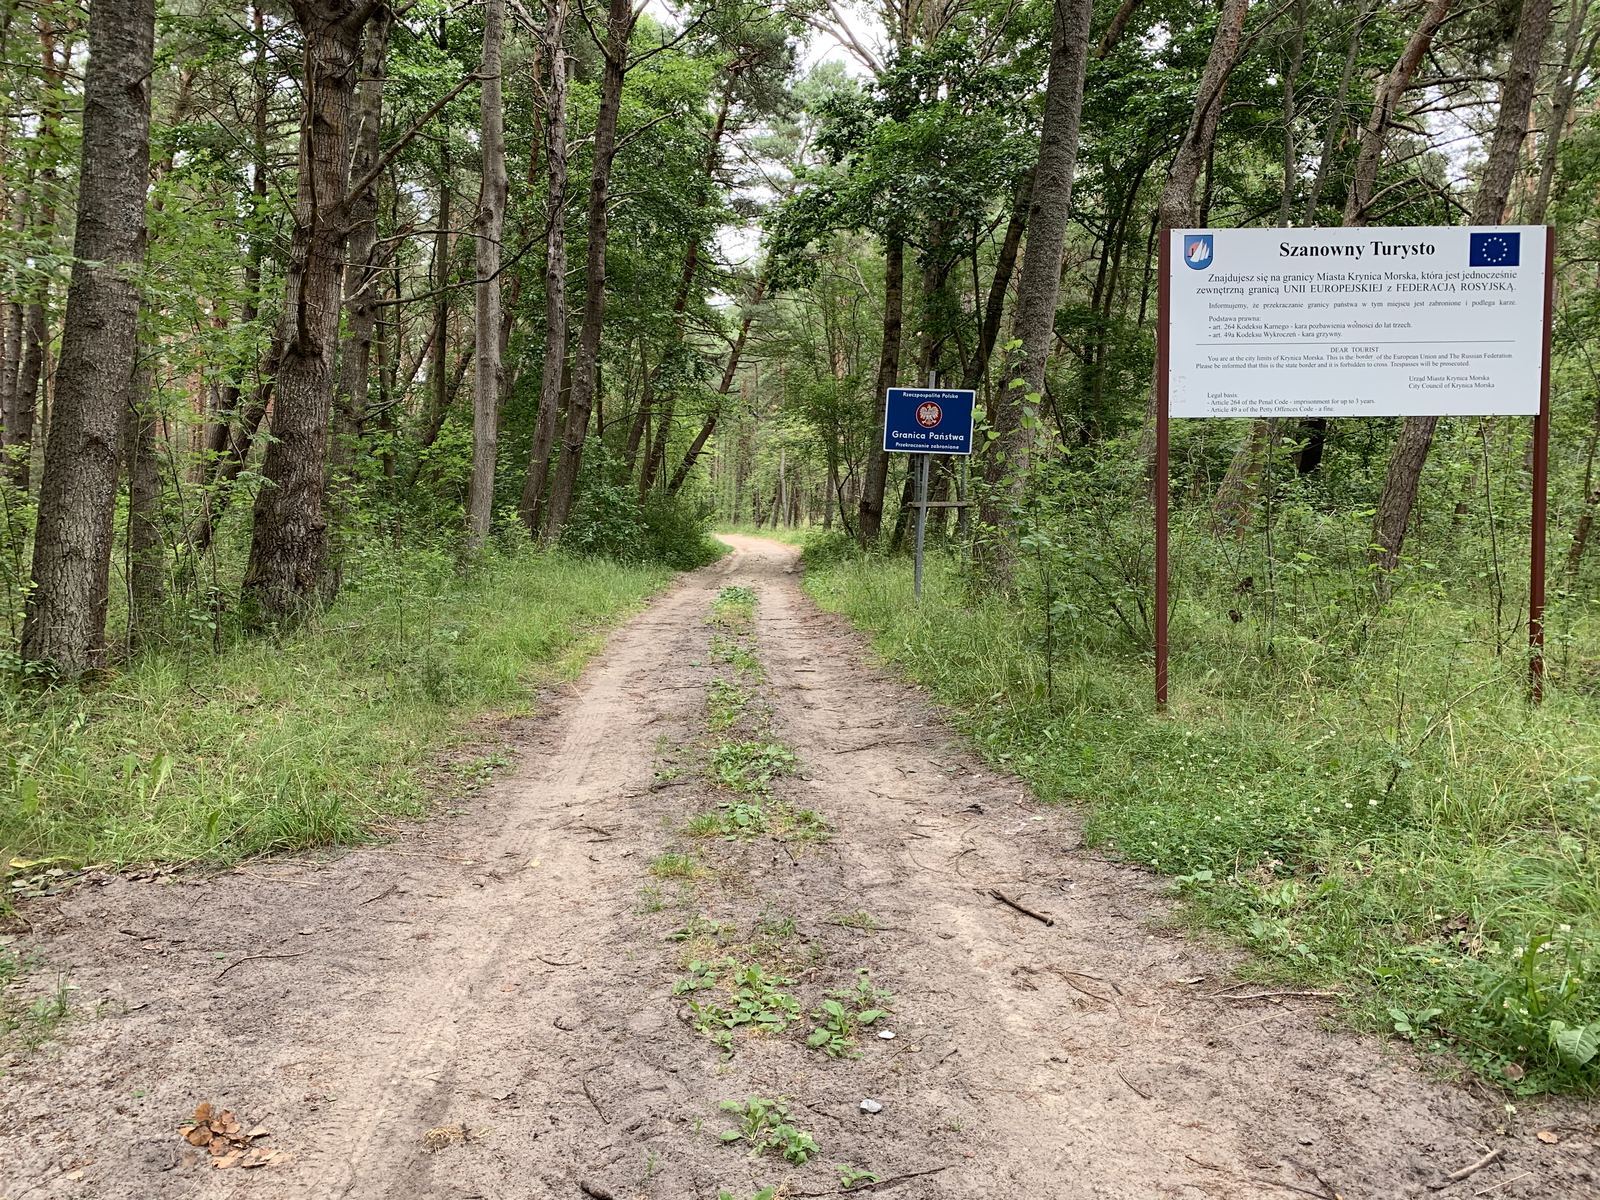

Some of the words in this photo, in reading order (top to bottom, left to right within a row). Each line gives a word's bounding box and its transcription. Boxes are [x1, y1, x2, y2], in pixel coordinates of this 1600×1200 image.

[1279, 242, 1365, 260] Szanowny
[1370, 241, 1435, 259] Turysto
[1208, 274, 1254, 284] Znajdujesz
[1256, 273, 1269, 283] się
[1283, 273, 1314, 283] granicy
[1316, 272, 1345, 281] Miasta
[1348, 272, 1382, 282] Krynica
[1384, 272, 1419, 282] Morska,
[1421, 271, 1443, 280] która
[1444, 271, 1460, 281] jest
[1462, 271, 1518, 281] jednocześnie
[1196, 284, 1244, 296] zewnętrzną
[1248, 284, 1279, 295] granicą
[1284, 284, 1306, 292] UNII
[1310, 283, 1383, 292] EUROPEJSKIEJ
[1396, 283, 1456, 294] FEDERACJĄ
[1460, 282, 1516, 293] ROSYJSKĄ.
[892, 430, 926, 439] Granica
[929, 432, 964, 441] Państwa
